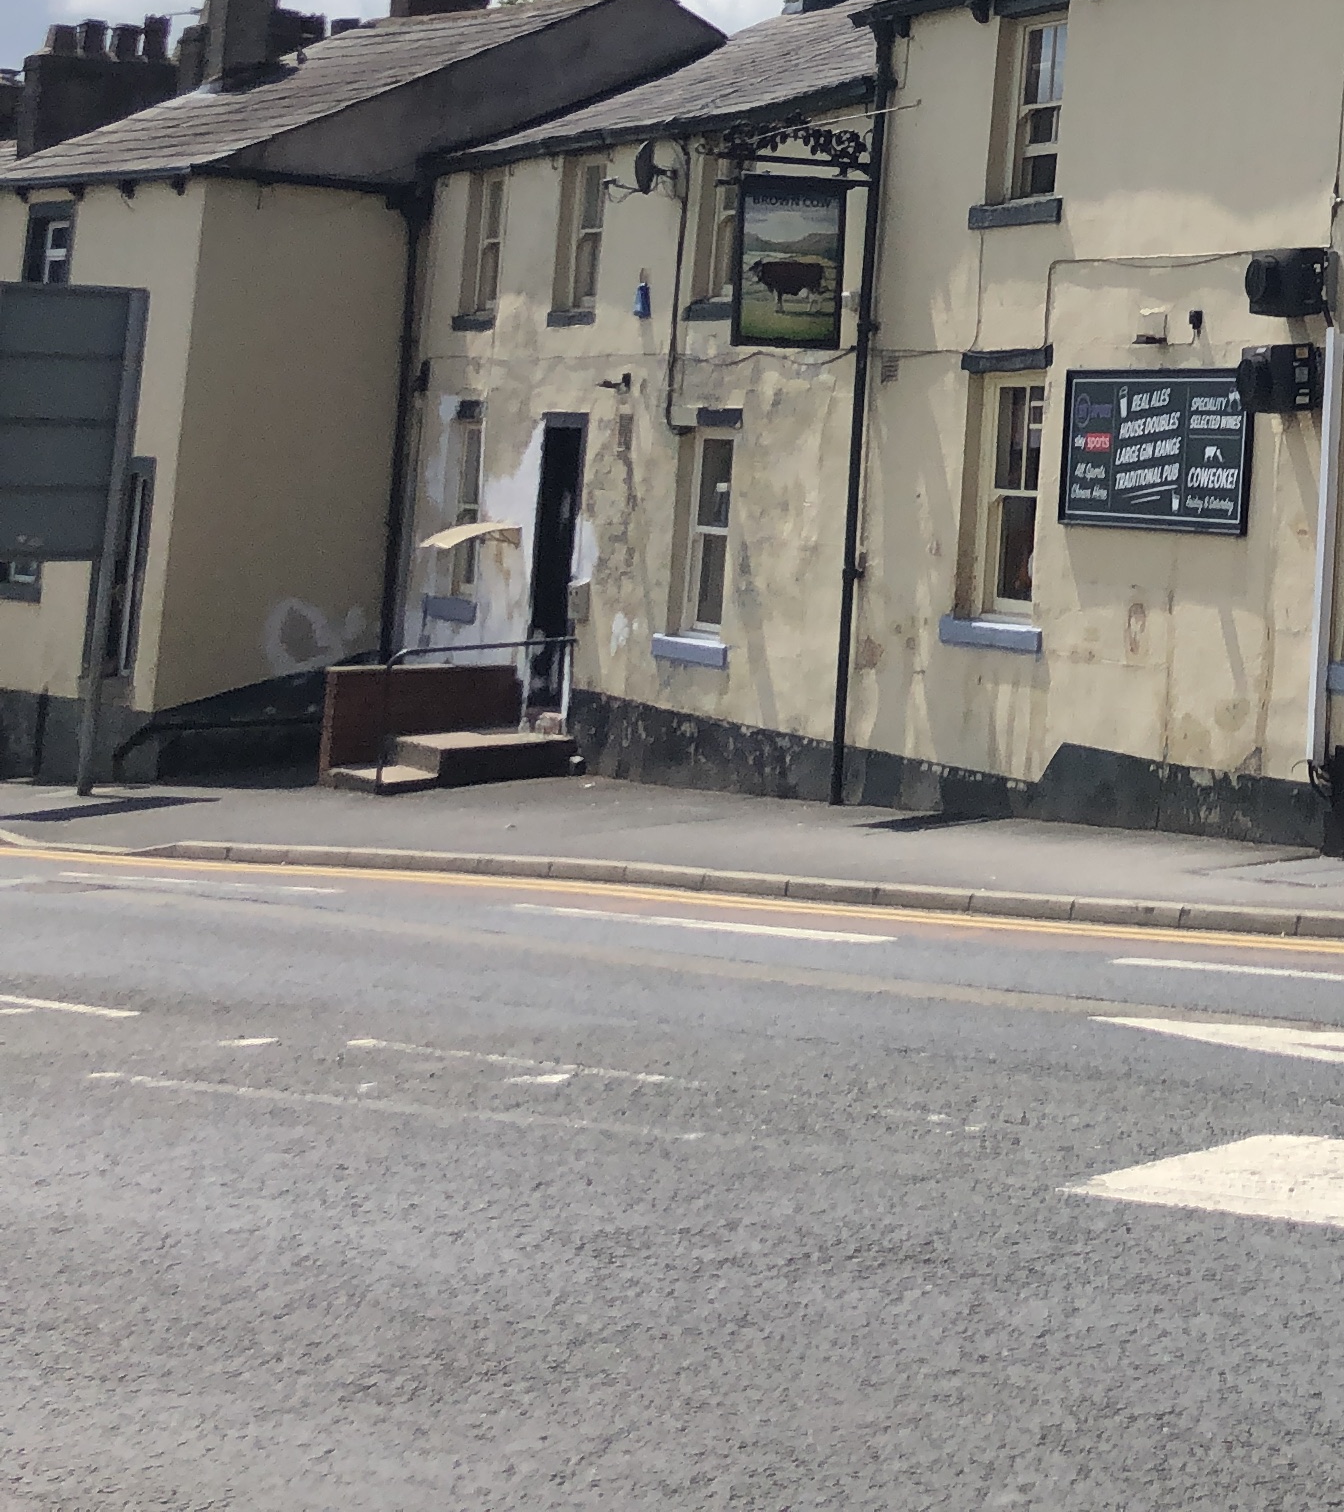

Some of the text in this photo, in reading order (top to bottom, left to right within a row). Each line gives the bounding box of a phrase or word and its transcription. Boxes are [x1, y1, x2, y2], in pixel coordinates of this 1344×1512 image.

[752, 194, 800, 206] BROWN
[1131, 392, 1150, 411] REAL
[1150, 388, 1171, 407] ALES
[1191, 397, 1228, 411] SPECIALITY
[1119, 411, 1181, 439] HOUSE DOUBLES
[1189, 415, 1242, 430] SELECTED WINES
[1074, 434, 1110, 450] sky sports
[1115, 436, 1181, 466] LARGE GIN RANGE
[1115, 462, 1180, 490] TRADITIONAL PUB
[1187, 467, 1239, 489] COWEOKE!
